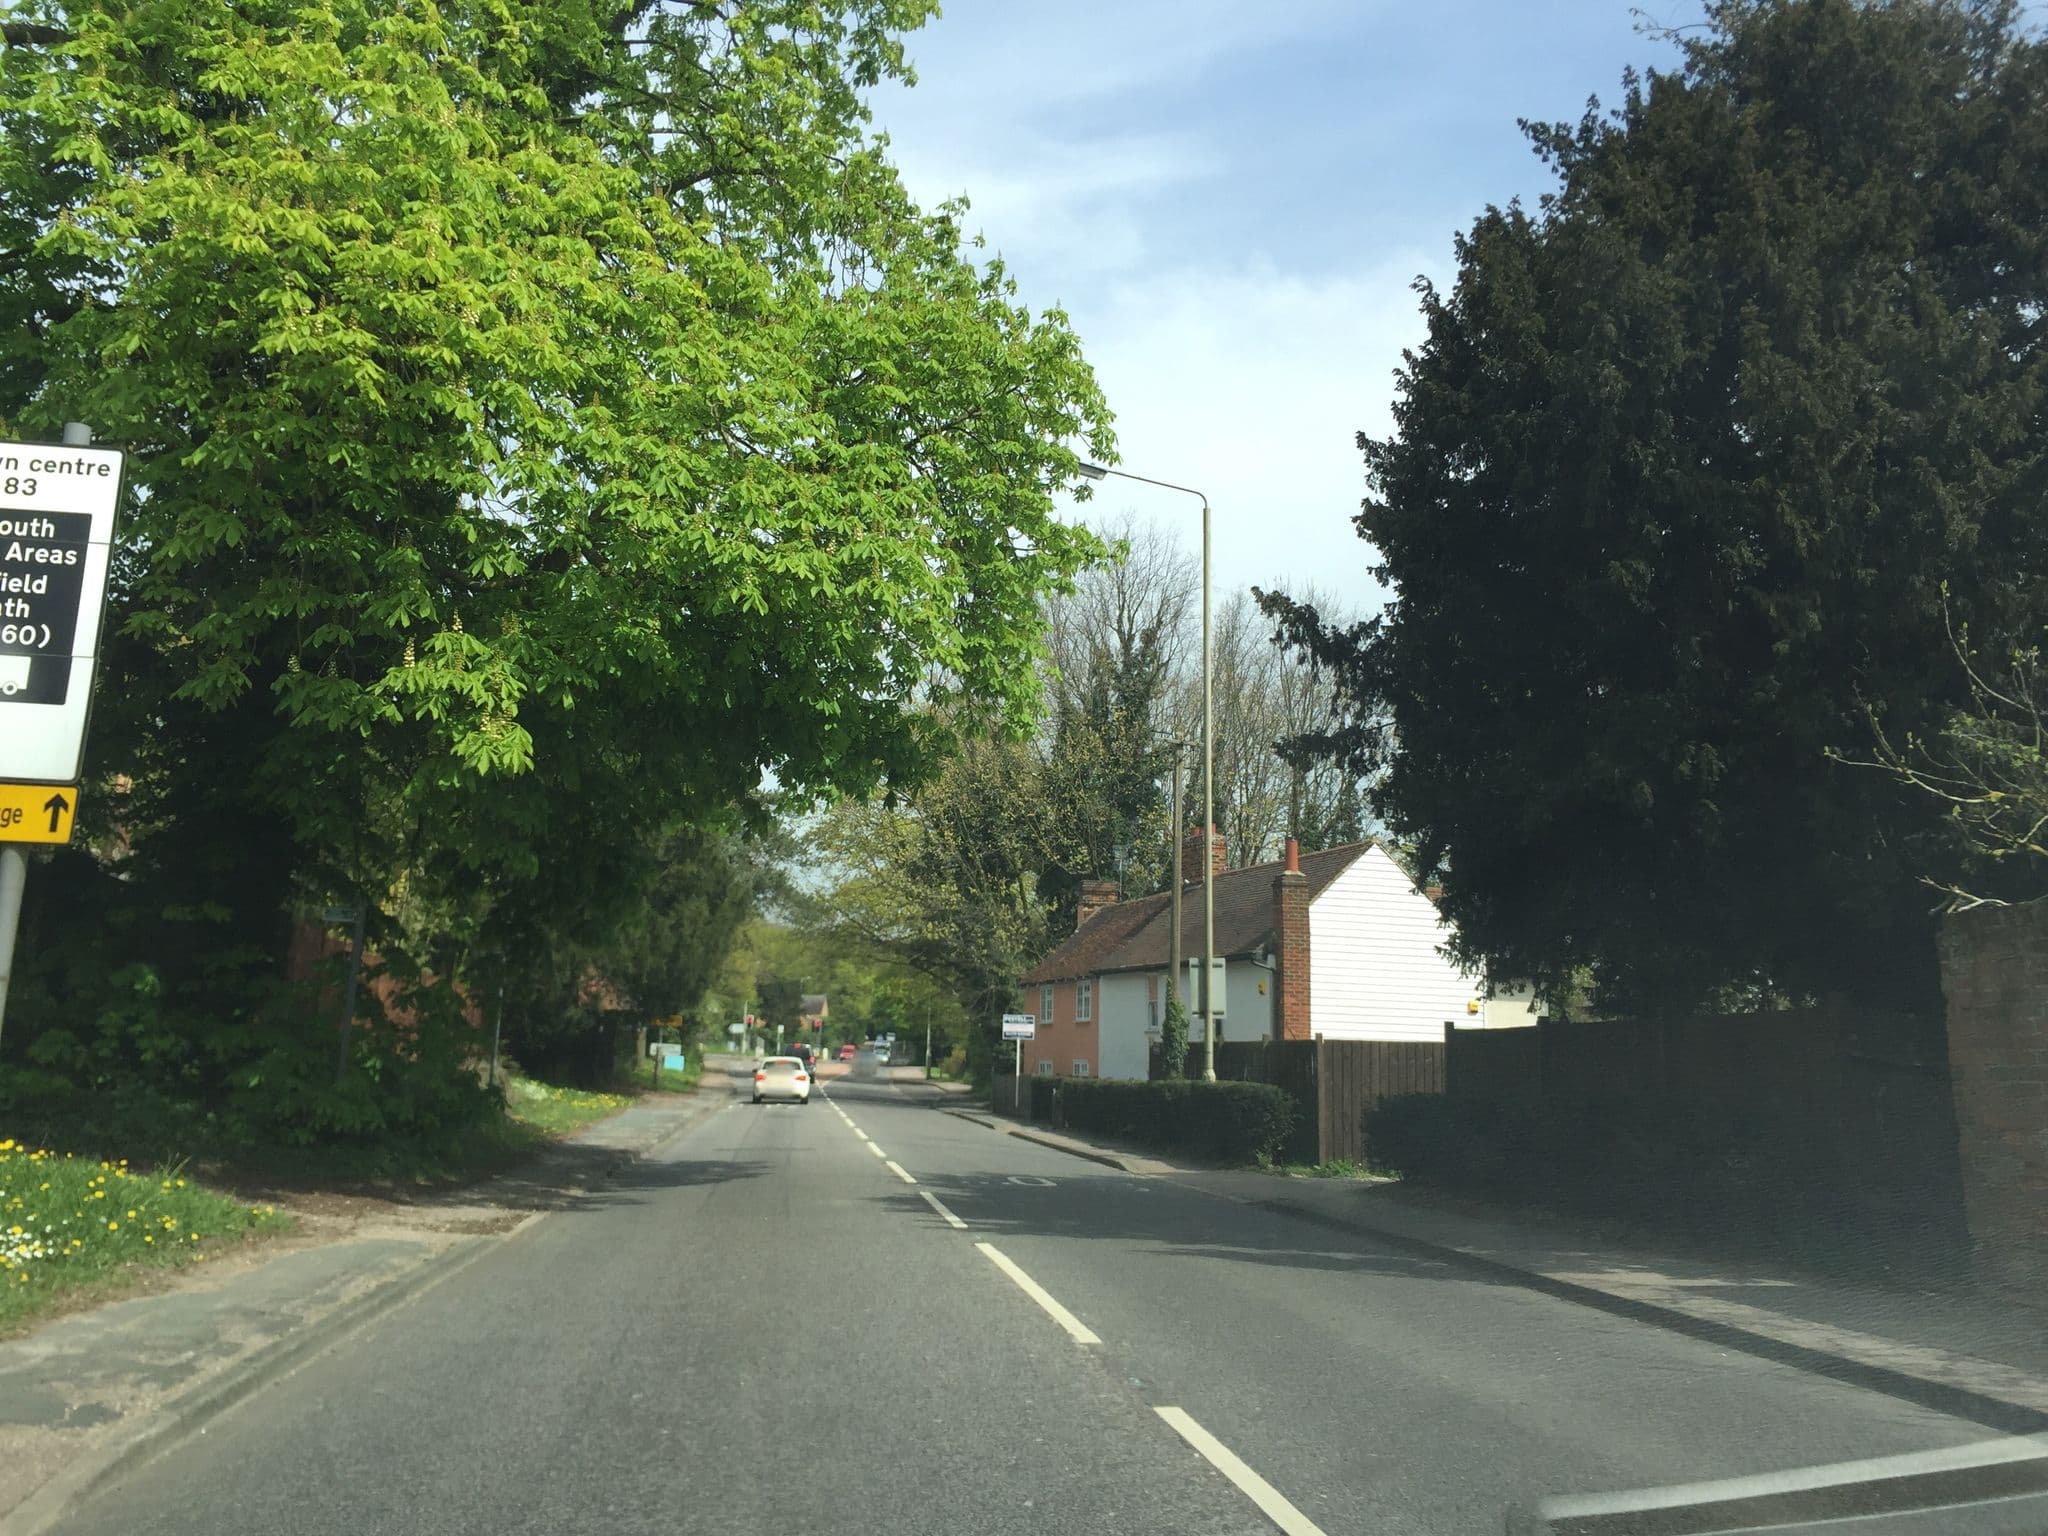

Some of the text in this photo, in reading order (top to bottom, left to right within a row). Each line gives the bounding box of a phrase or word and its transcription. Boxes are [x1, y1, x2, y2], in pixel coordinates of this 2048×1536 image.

[0, 457, 110, 477] n centre
[4, 477, 37, 496] 83
[0, 518, 55, 538] outh
[5, 541, 78, 565] Areas
[0, 572, 48, 594] ield
[0, 598, 30, 618] th
[1, 624, 51, 648] 60)
